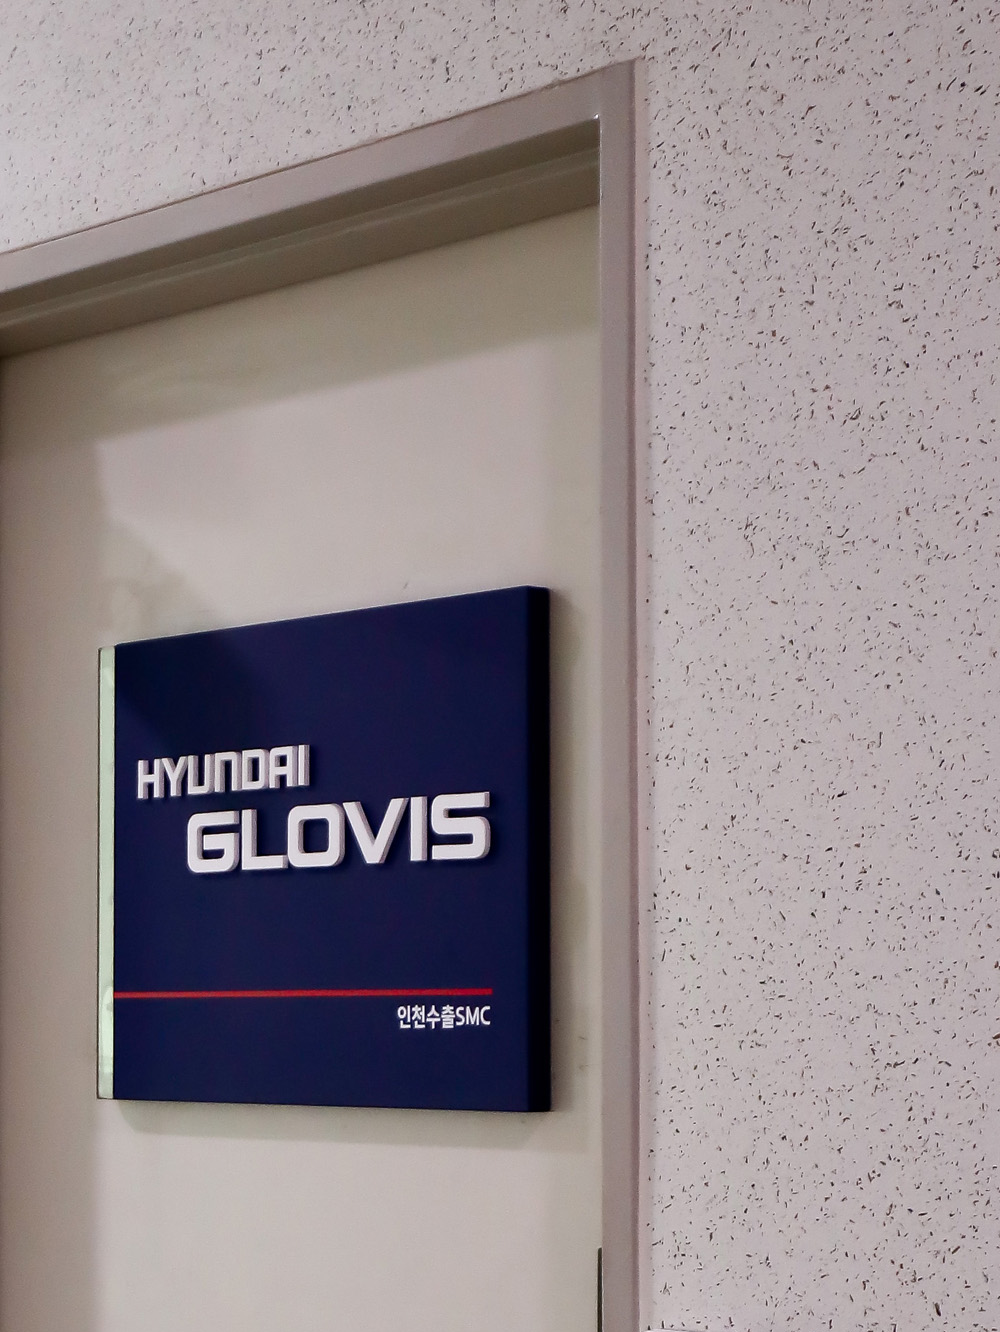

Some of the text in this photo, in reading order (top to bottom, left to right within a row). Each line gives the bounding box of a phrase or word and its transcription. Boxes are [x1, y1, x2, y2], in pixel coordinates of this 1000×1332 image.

[137, 744, 310, 799] HYUNDAI
[187, 791, 491, 873] GLOVIS
[397, 1005, 491, 1029] 인천수출SMC
